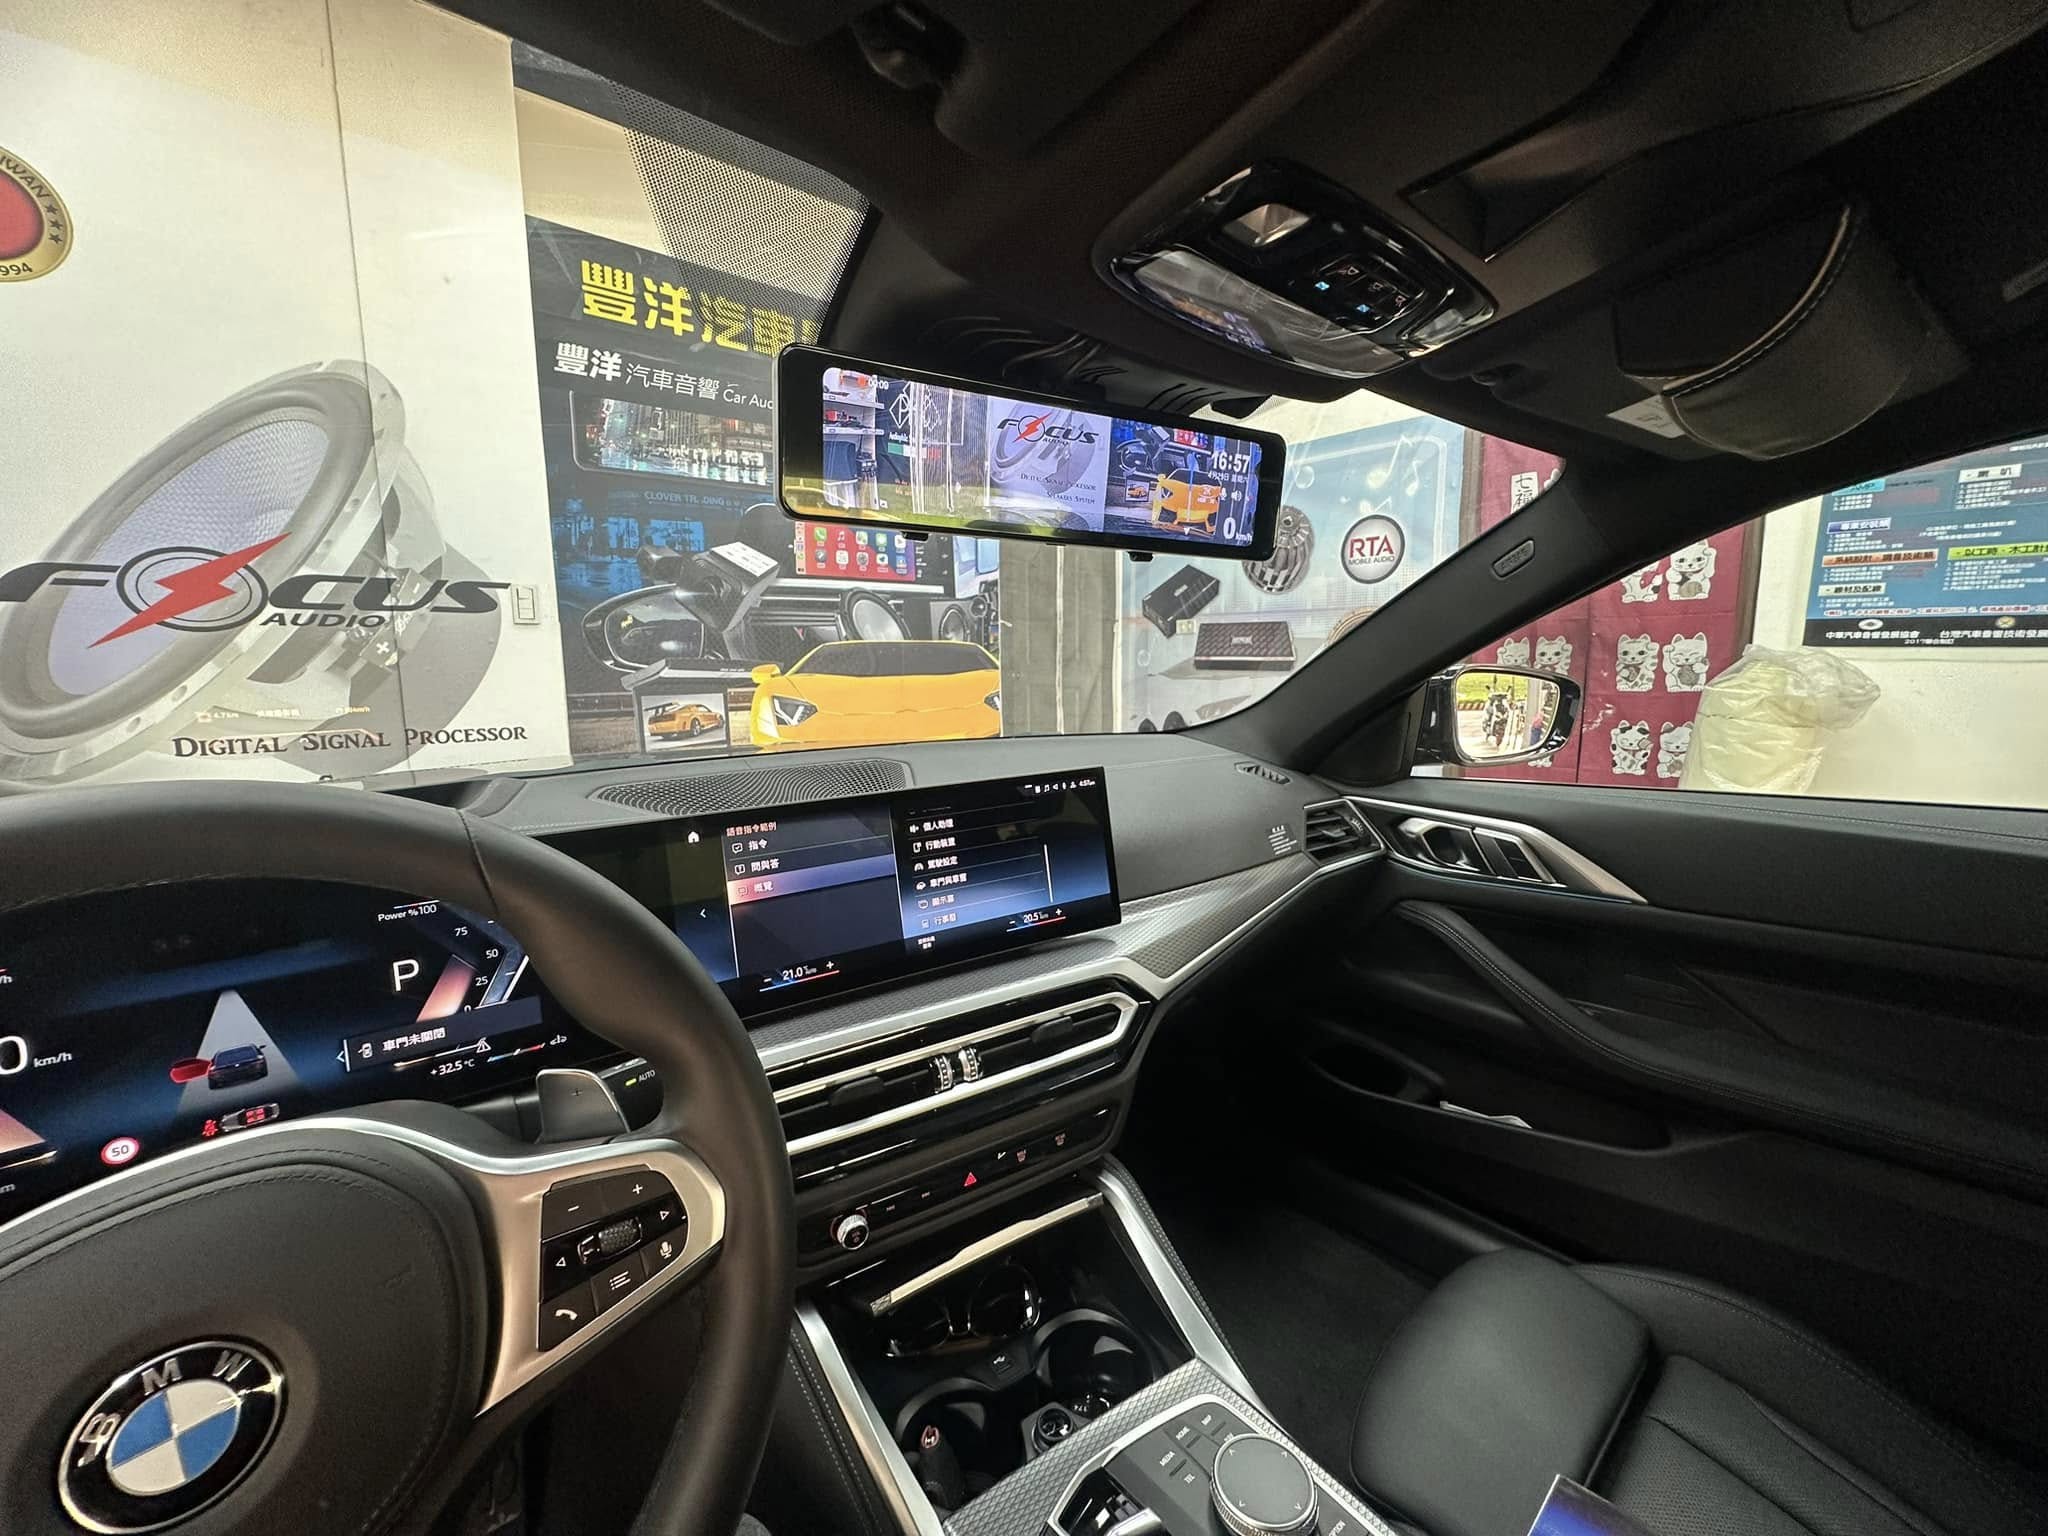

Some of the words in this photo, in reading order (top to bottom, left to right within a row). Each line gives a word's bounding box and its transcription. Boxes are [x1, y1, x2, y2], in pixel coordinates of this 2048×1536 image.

[625, 362, 720, 401] 汽車音響
[722, 388, 748, 405] Car
[997, 413, 1099, 444] FOCUS
[1211, 450, 1251, 473] 16:57
[1223, 517, 1236, 539] 0
[1349, 534, 1394, 558] RTA
[1373, 555, 1395, 564] AUDIO
[260, 612, 386, 628] AUDIO
[173, 735, 288, 758] DIGITAL
[302, 732, 391, 751] SIGNAL
[404, 726, 528, 746] PROCESSOR
[748, 838, 768, 851] 指令
[377, 910, 407, 922] Power
[454, 926, 469, 937] 75
[485, 948, 499, 960] 50
[392, 959, 420, 993] P
[475, 975, 489, 987] 25
[782, 966, 804, 981] 21.0
[0, 1035, 28, 1076] 0
[33, 1051, 73, 1069] km/h
[638, 1069, 656, 1082] AUTO
[111, 1144, 130, 1158] 50
